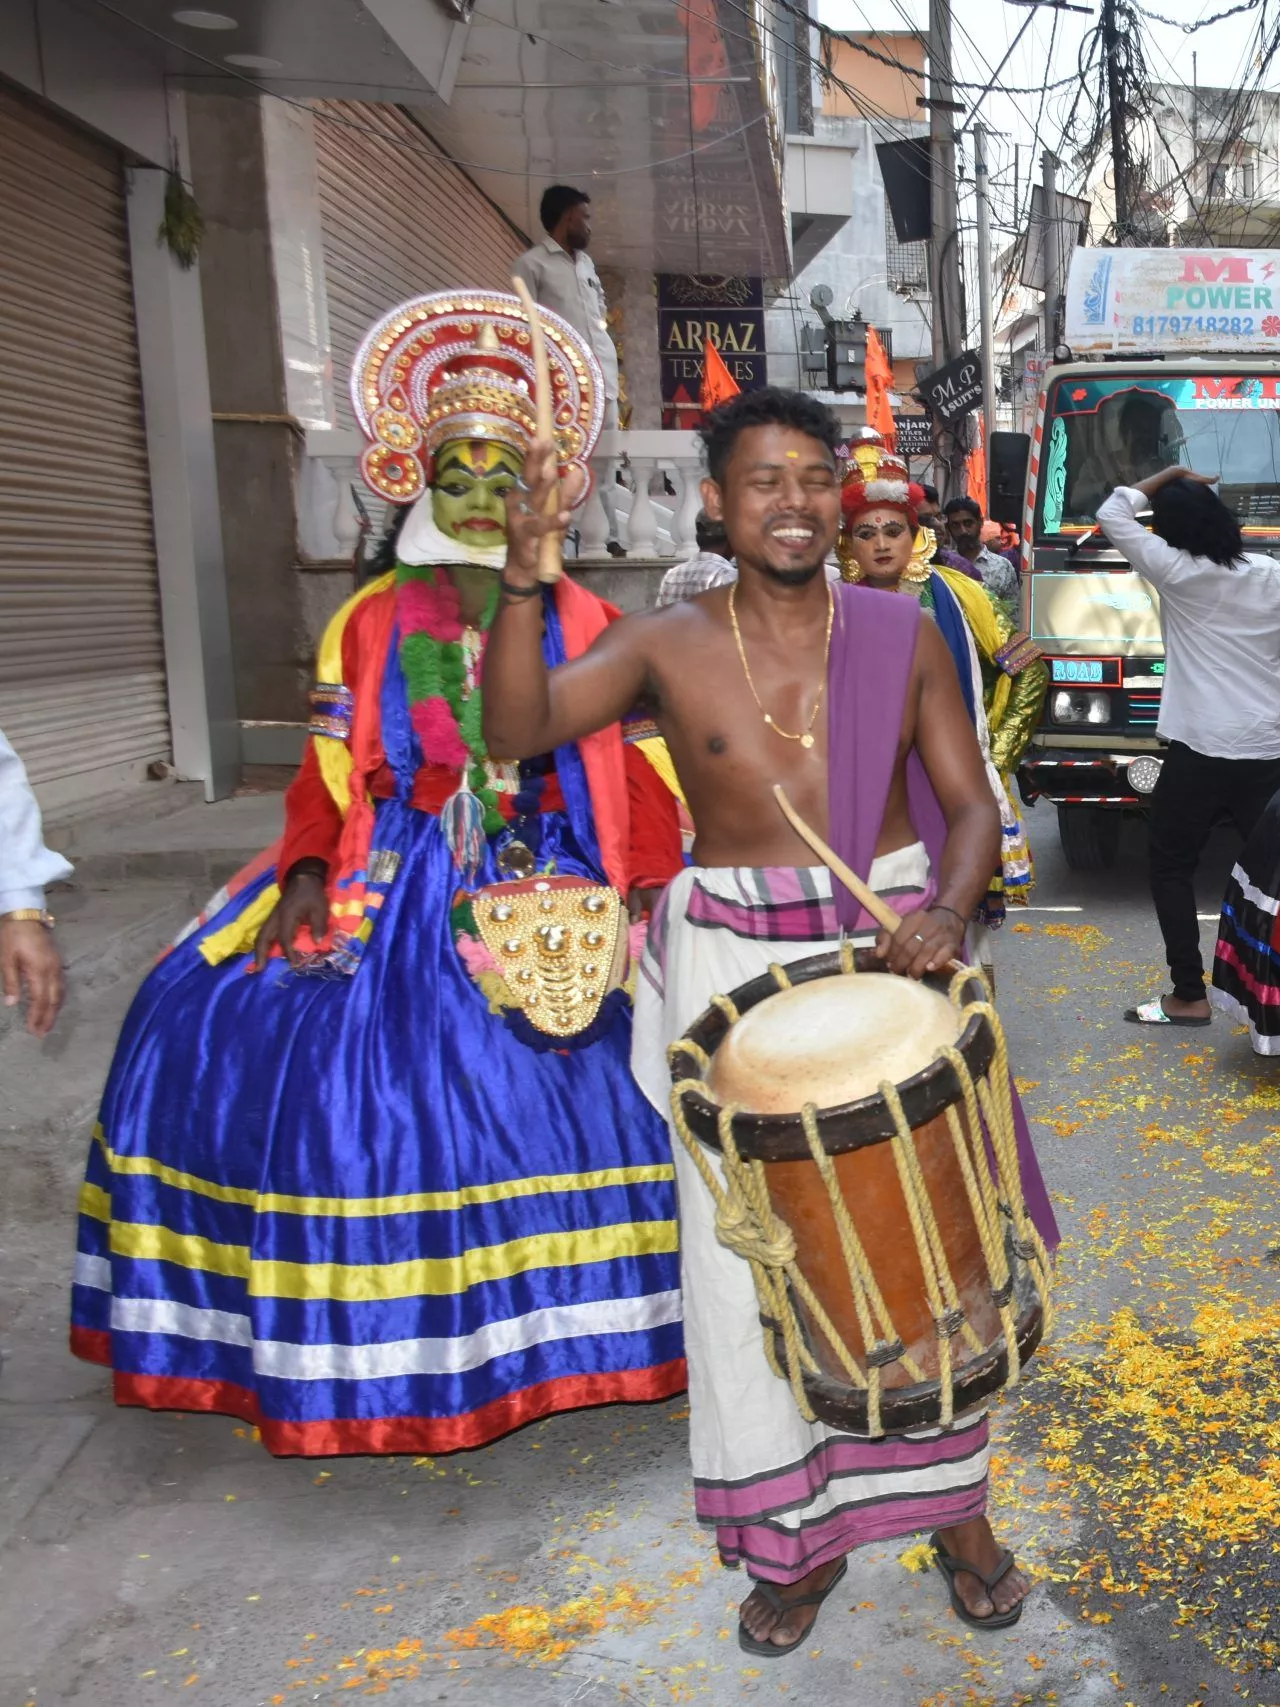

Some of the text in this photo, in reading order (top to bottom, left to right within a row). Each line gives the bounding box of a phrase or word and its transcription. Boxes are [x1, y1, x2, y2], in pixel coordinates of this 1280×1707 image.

[1178, 256, 1254, 283] M
[1166, 286, 1273, 310] POWER
[667, 320, 757, 353] ARBAZ
[1132, 315, 1255, 337] 8179718282
[668, 358, 755, 381] TEXES
[931, 364, 976, 406] M.P
[1191, 377, 1244, 399] M
[1195, 398, 1252, 409] POWER
